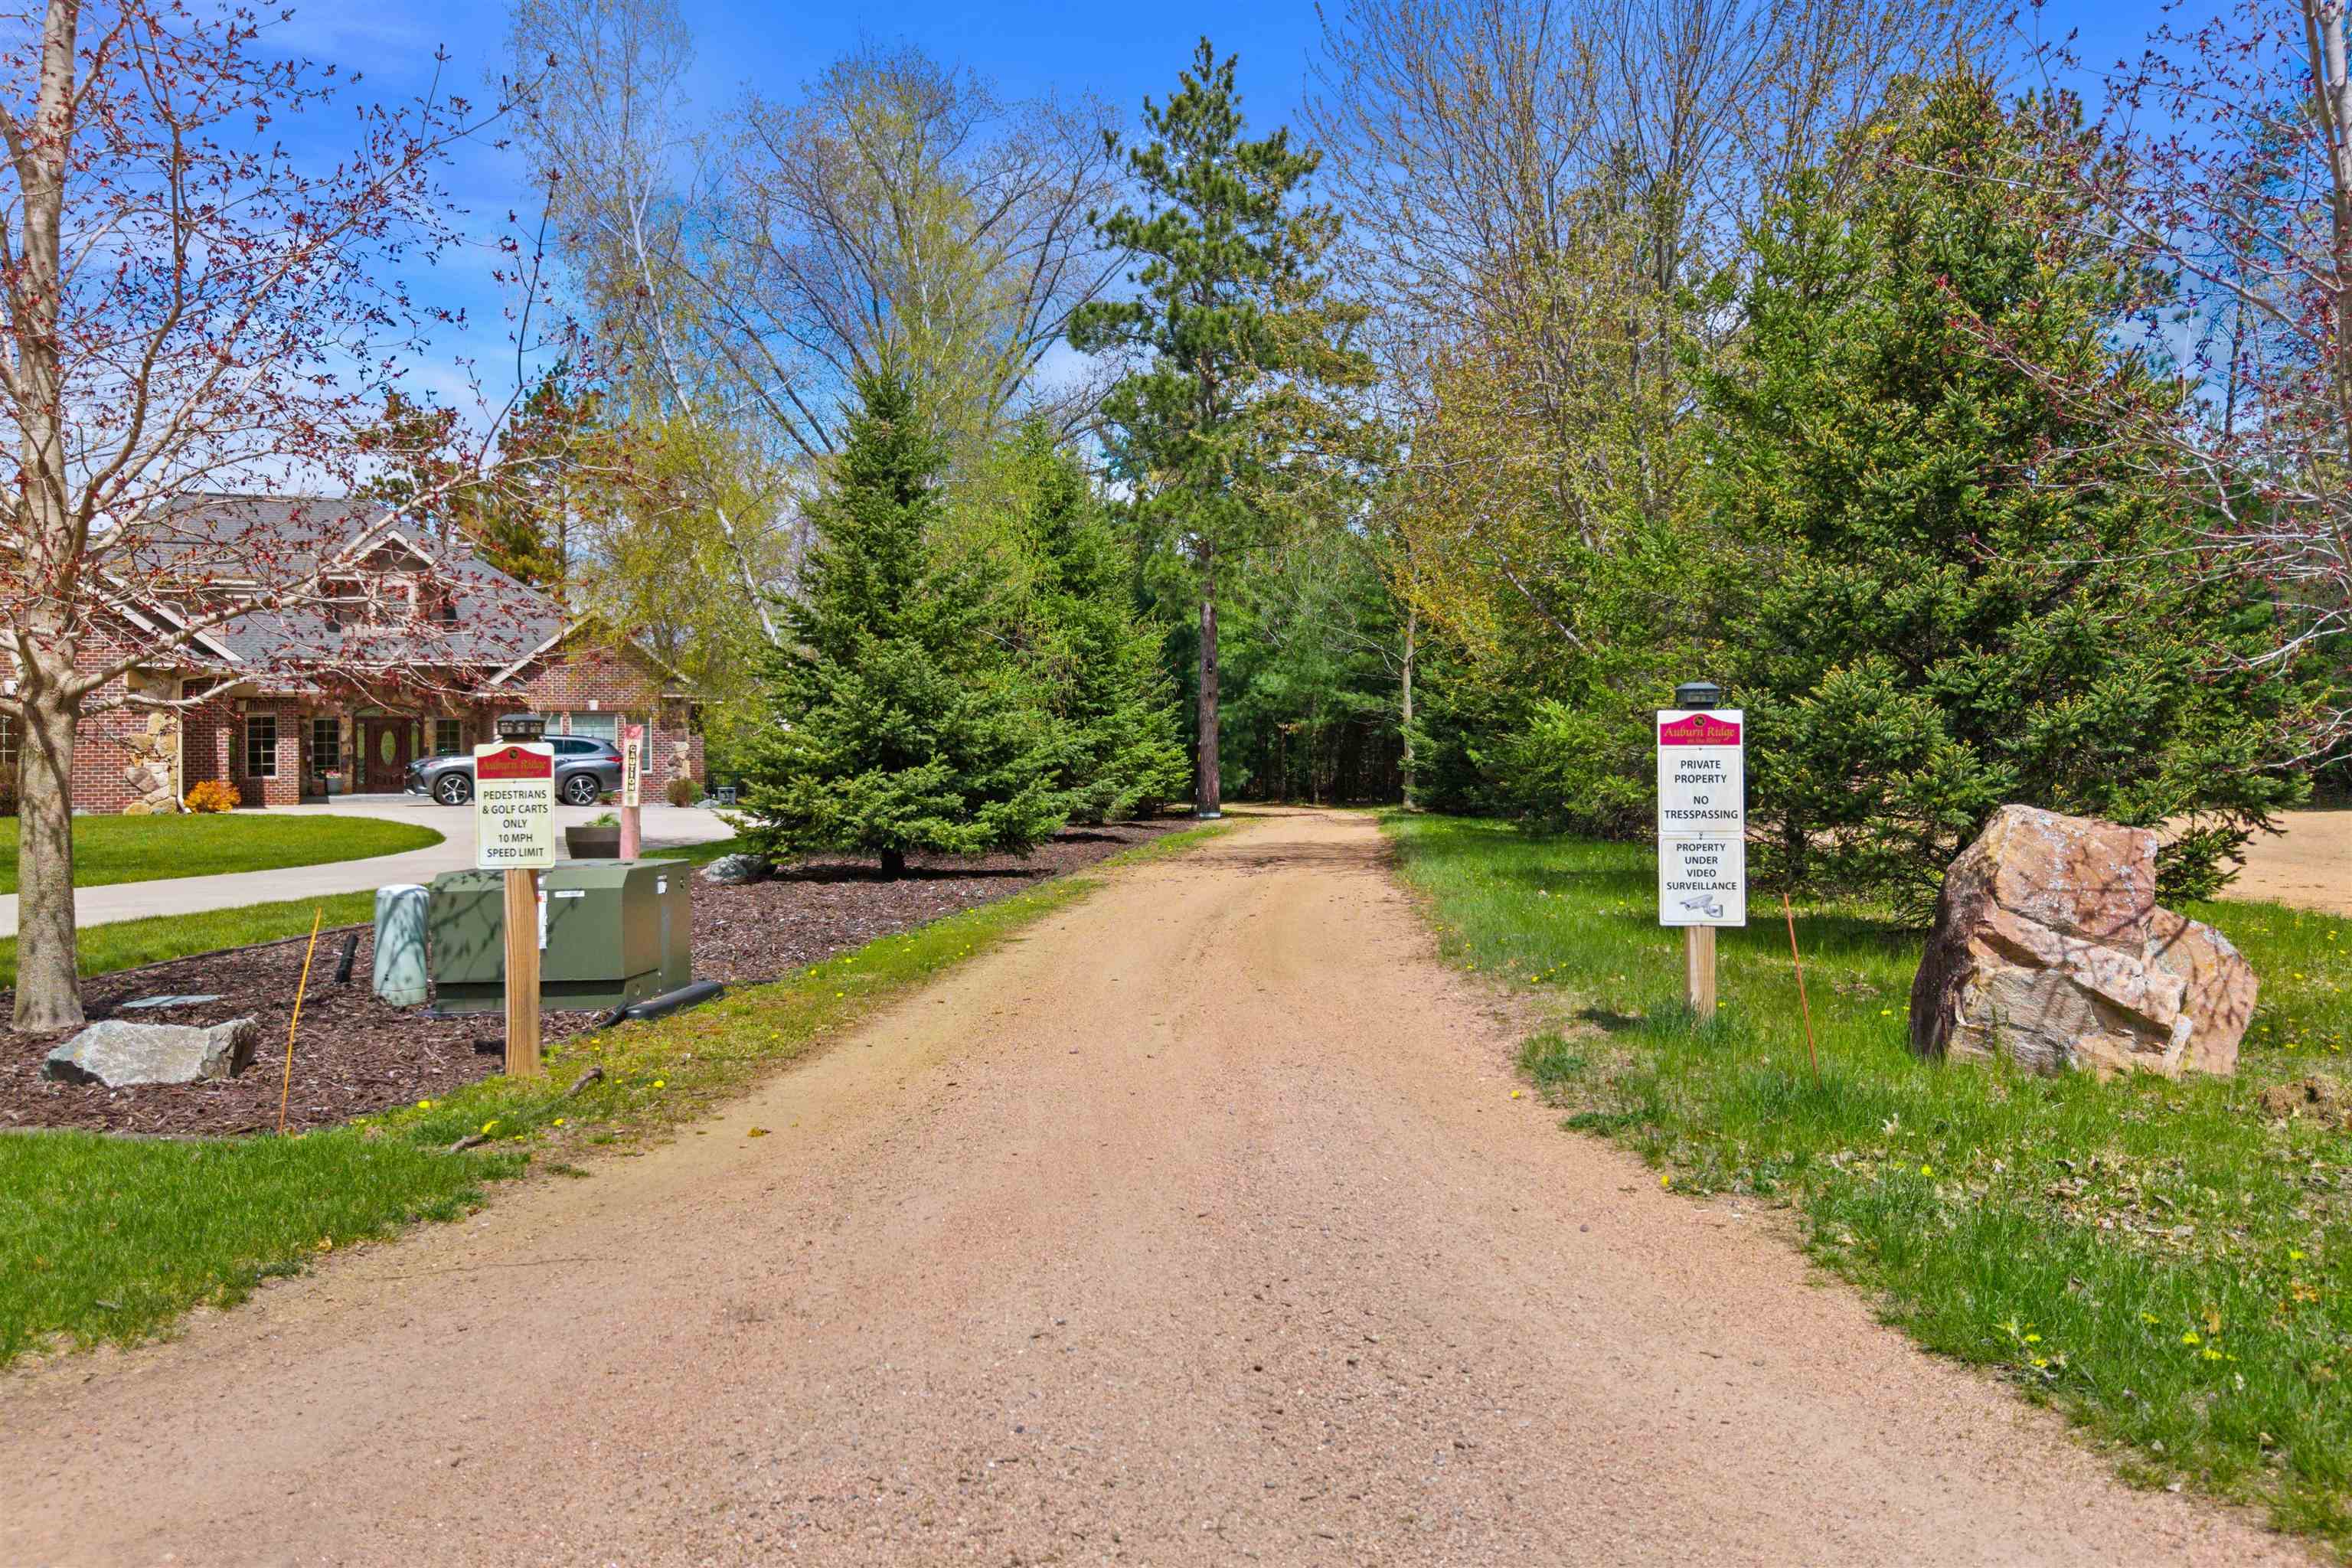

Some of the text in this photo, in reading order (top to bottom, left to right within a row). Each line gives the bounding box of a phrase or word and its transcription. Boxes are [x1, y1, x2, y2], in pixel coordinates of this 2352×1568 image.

[1665, 725, 1735, 741] Auburn Ridge
[1680, 760, 1721, 769] PRIVATE
[1674, 774, 1727, 783] PROPERTY
[483, 790, 547, 800] PEDESTRIANS
[1693, 795, 1709, 805] NO
[482, 804, 548, 814] & GOLF CARTS
[1664, 810, 1739, 819] TRESSPASSING
[503, 819, 528, 828] ONLY
[498, 834, 533, 843] 10 MPH
[1676, 843, 1726, 852] PROPERTY
[487, 848, 544, 858] SPEED LIMIT
[1685, 856, 1718, 864] UNDER
[1687, 869, 1717, 877] VIDEO
[1667, 882, 1737, 890] SURVEILLANCE
